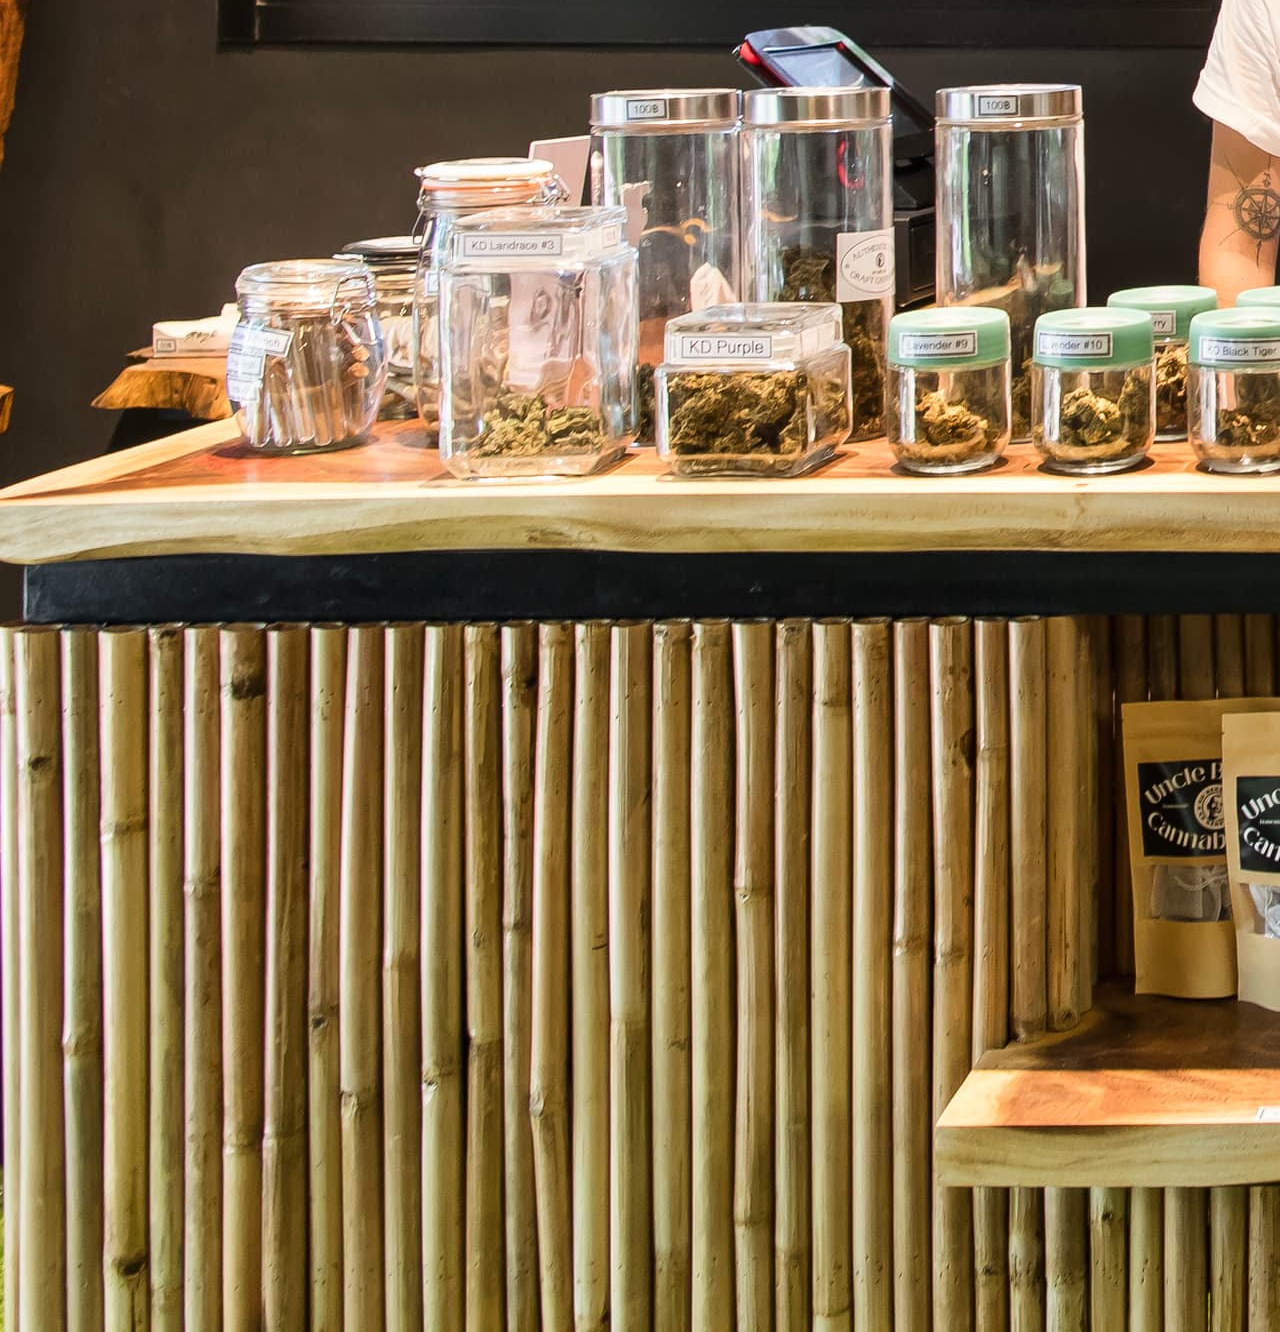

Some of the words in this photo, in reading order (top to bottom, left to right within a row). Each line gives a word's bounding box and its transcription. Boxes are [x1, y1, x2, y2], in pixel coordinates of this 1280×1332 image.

[471, 240, 487, 251] KD
[489, 239, 538, 251] Landrace
[540, 239, 555, 251] #3
[689, 338, 712, 354] KD
[716, 338, 764, 357] Purple
[954, 339, 968, 349] #9
[1083, 340, 1103, 350] #10
[1222, 346, 1249, 357] Black
[1145, 764, 1206, 803] Uncle
[1147, 812, 1225, 851] Cannab
